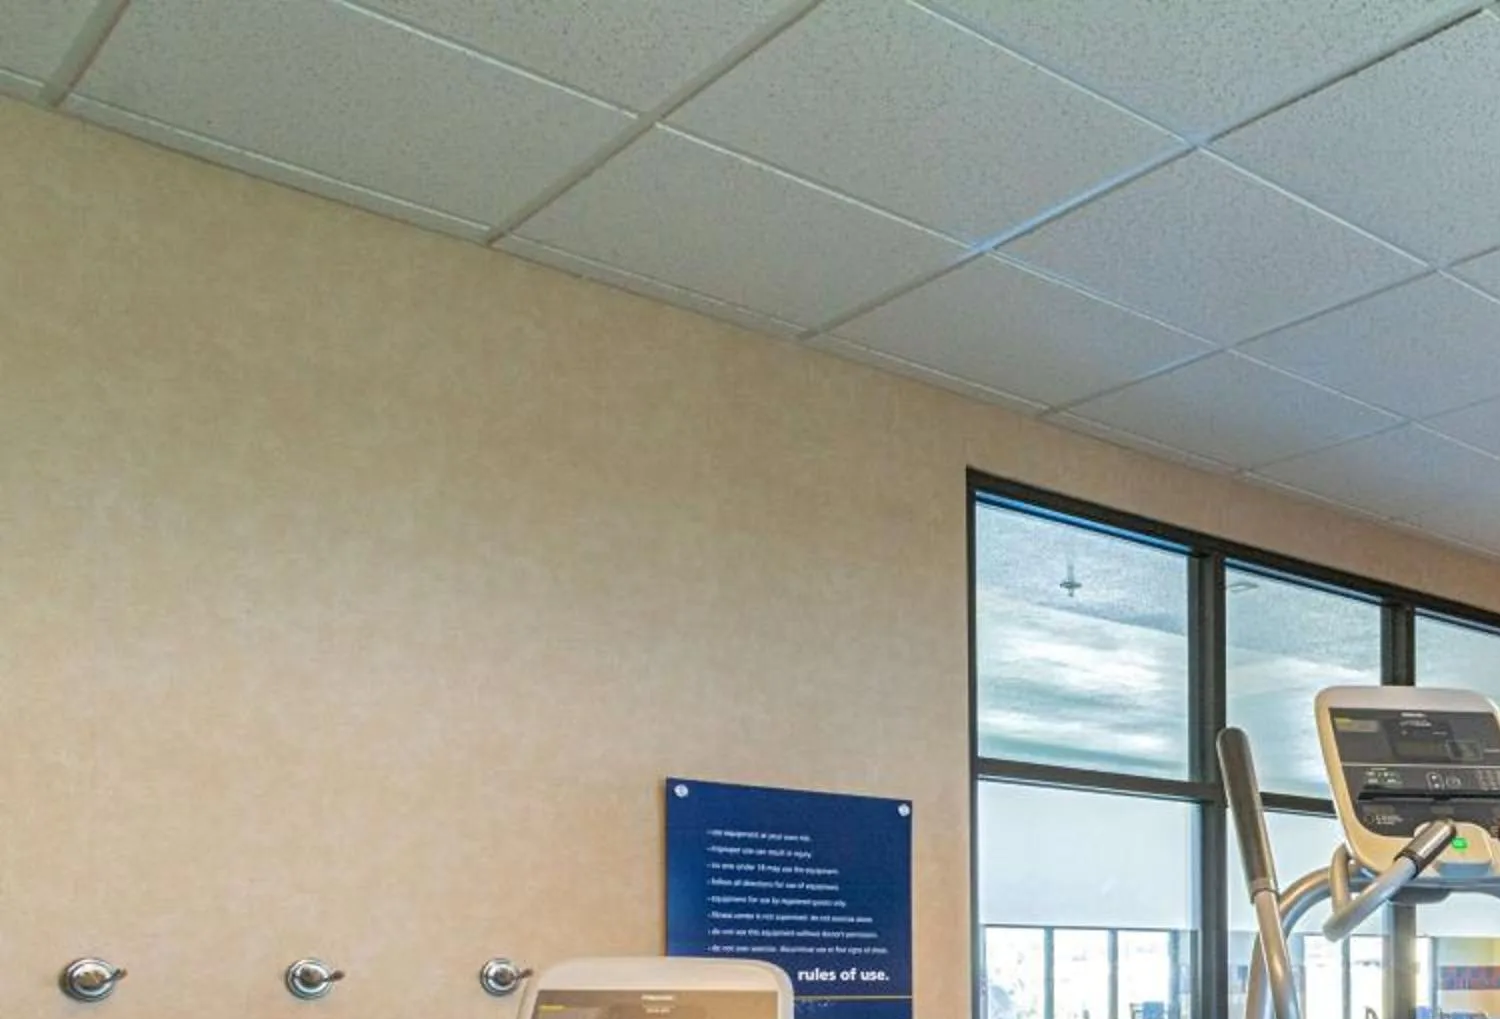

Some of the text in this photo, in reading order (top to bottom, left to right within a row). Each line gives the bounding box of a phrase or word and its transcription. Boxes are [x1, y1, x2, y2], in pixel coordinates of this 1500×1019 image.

[797, 968, 890, 981] rules of use.
